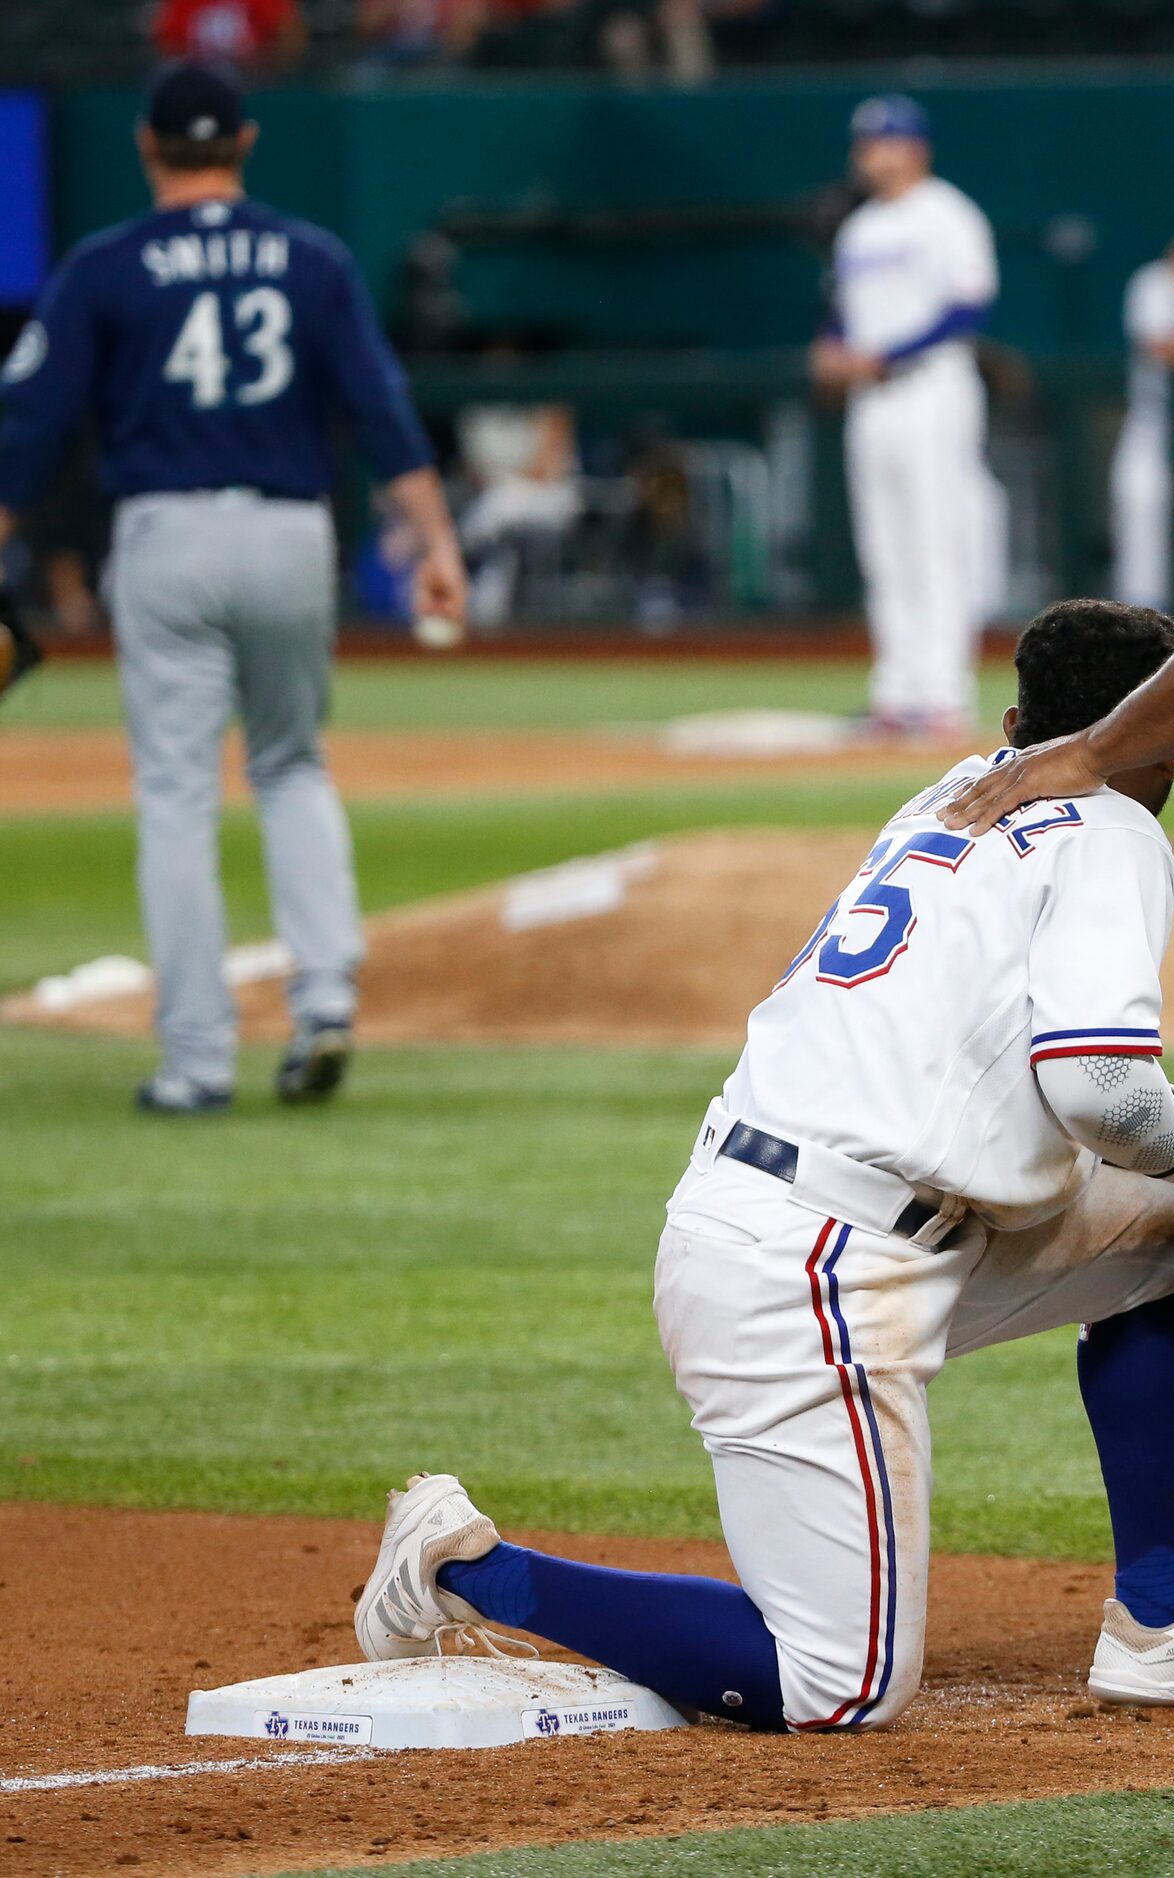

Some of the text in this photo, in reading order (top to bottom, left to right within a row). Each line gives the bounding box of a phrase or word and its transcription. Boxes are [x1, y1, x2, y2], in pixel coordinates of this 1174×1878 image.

[141, 229, 290, 286] SMITH
[163, 287, 295, 409] 43
[294, 1719, 360, 1734] TEXAS RANGERS
[563, 1709, 629, 1725] TEXAS RANGERS
